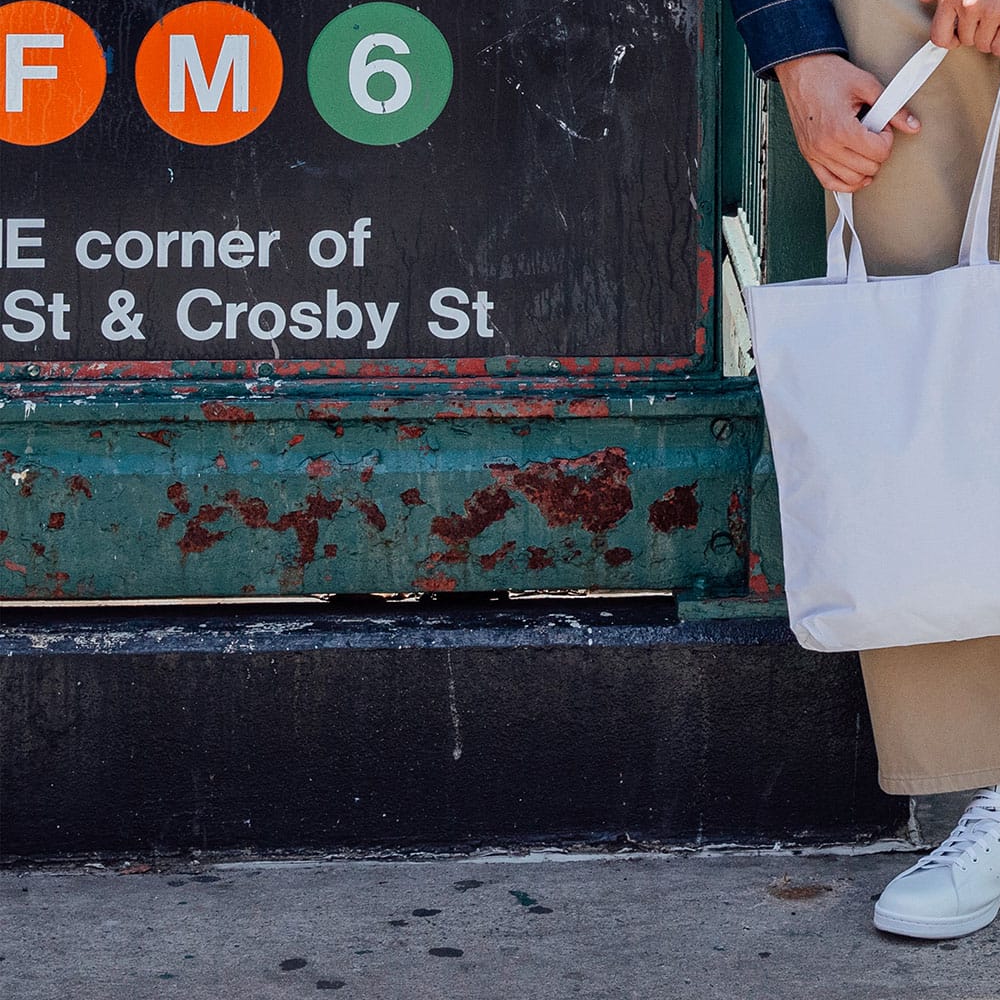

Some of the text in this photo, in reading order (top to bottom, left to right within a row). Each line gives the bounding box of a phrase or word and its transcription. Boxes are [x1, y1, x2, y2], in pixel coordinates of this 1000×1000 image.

[5, 34, 64, 112] F
[169, 34, 249, 112] M
[348, 32, 413, 114] 6
[0, 217, 371, 269] E corner of
[2, 287, 495, 350] St & Crosby St
